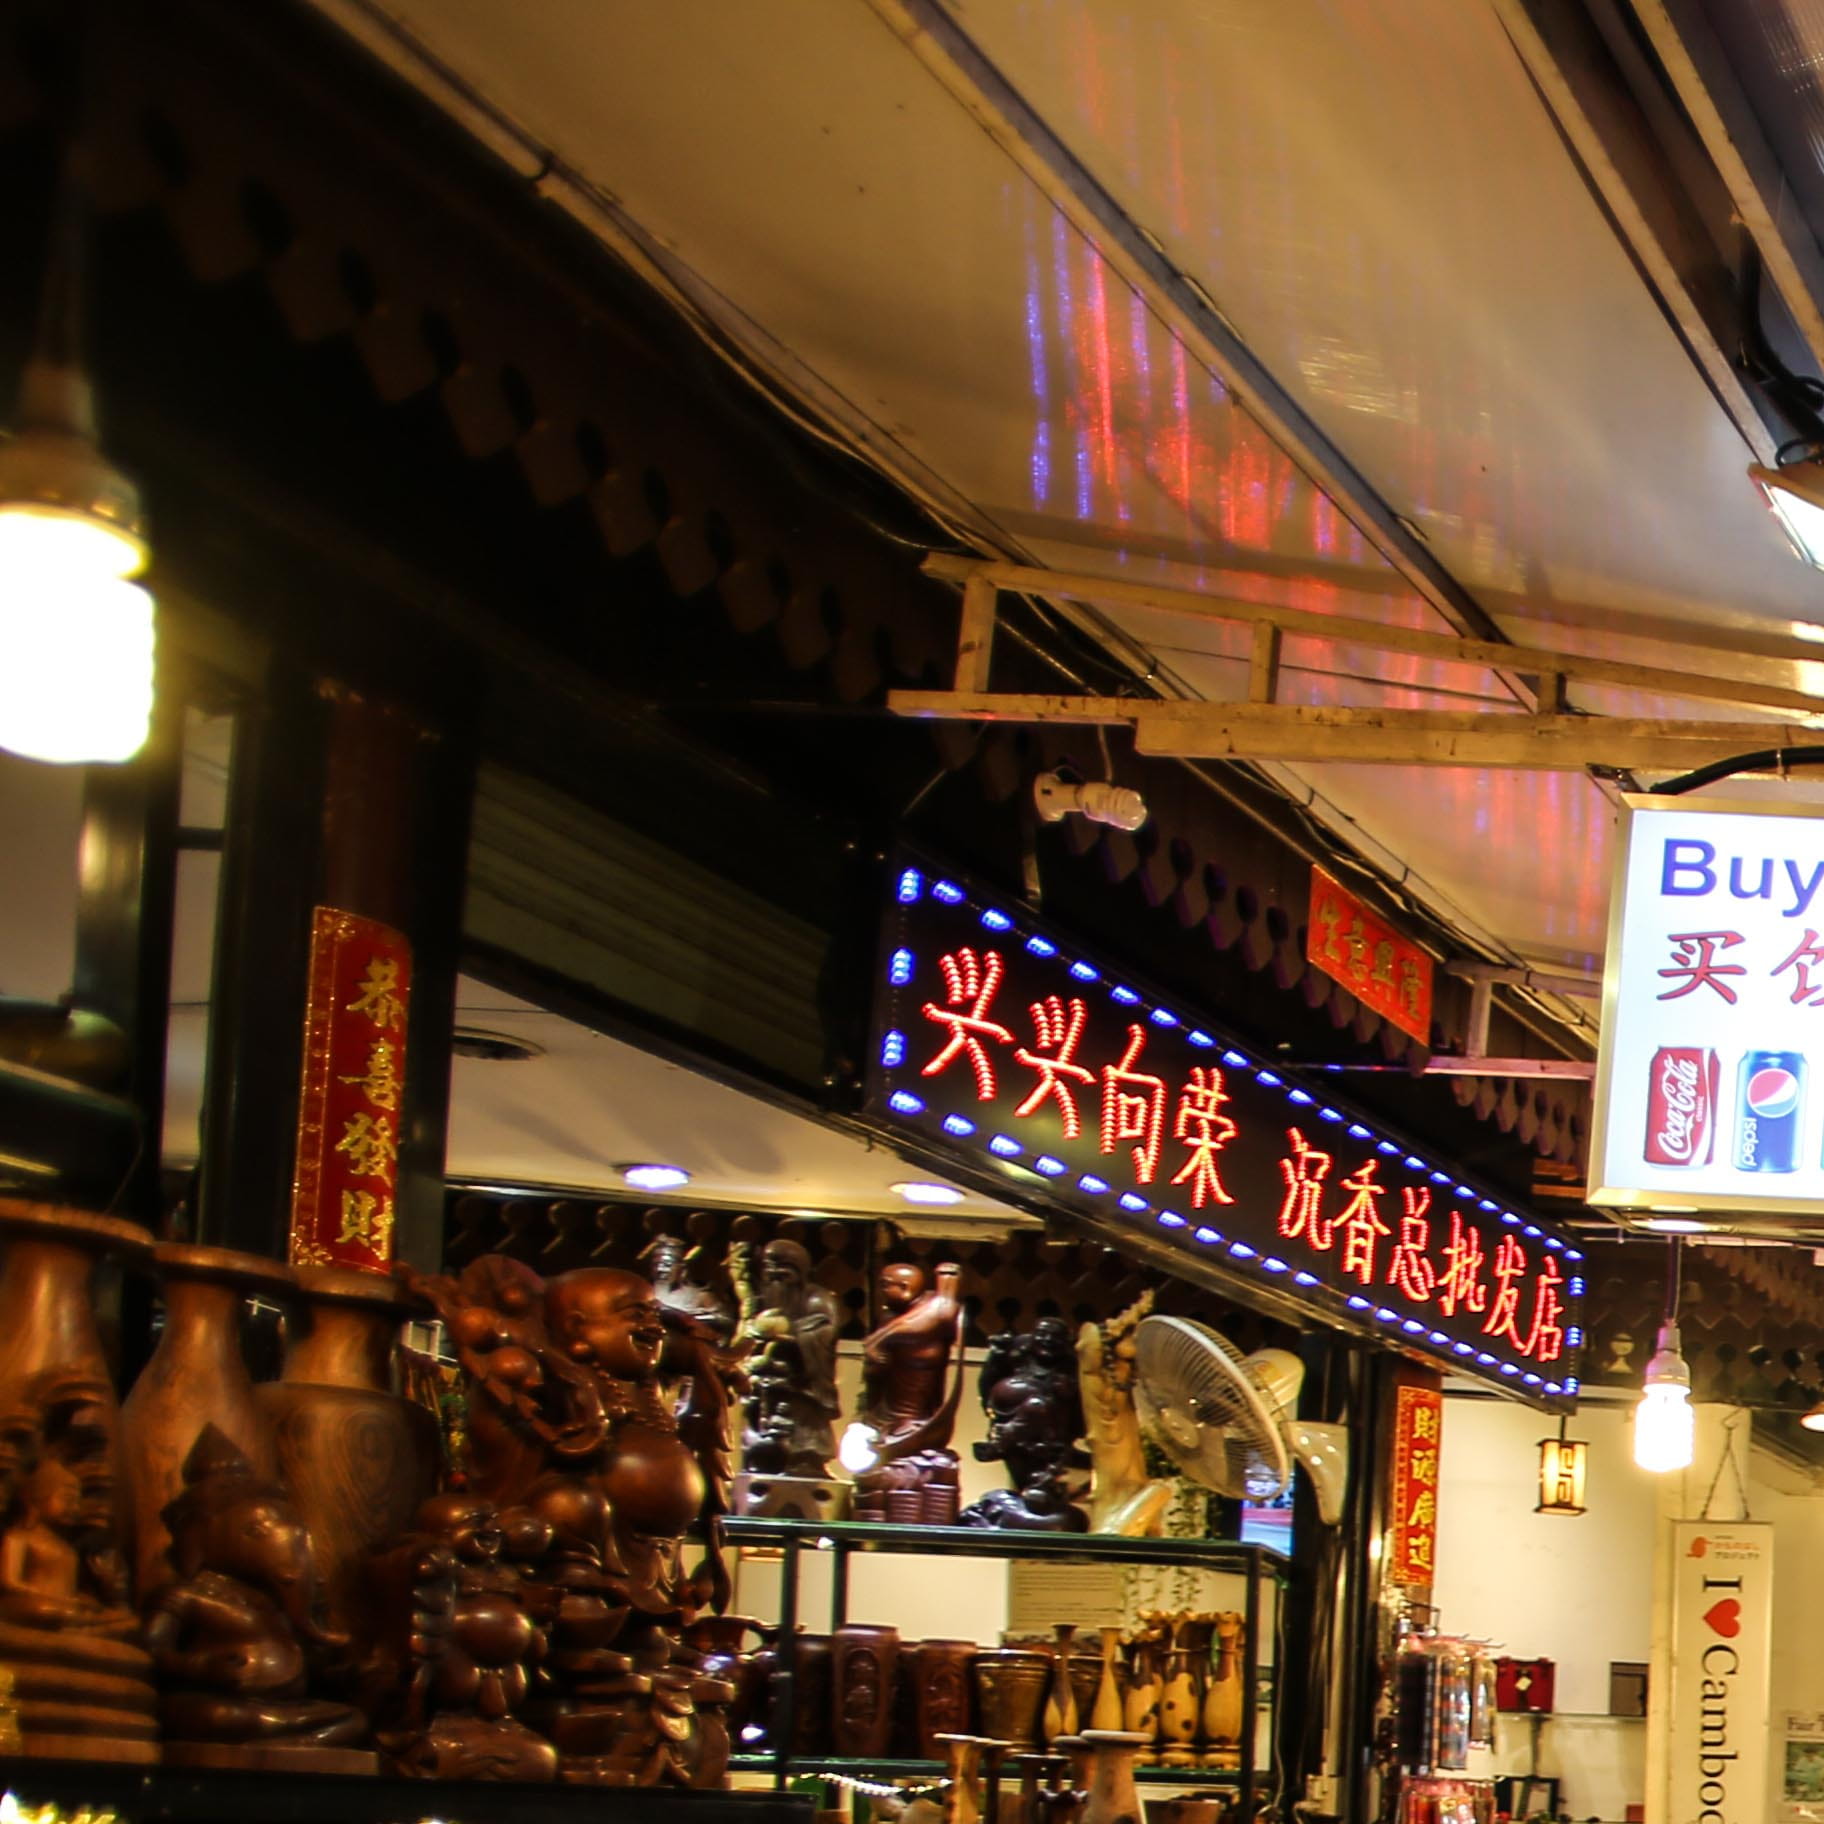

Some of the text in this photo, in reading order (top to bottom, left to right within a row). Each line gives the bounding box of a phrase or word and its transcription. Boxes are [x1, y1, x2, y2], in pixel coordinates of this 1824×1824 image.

[921, 946, 1567, 1363] 兴兴向荣 沉香总批发店
[1740, 1117, 1757, 1167] pepsi
[1702, 1574, 1743, 1594] I
